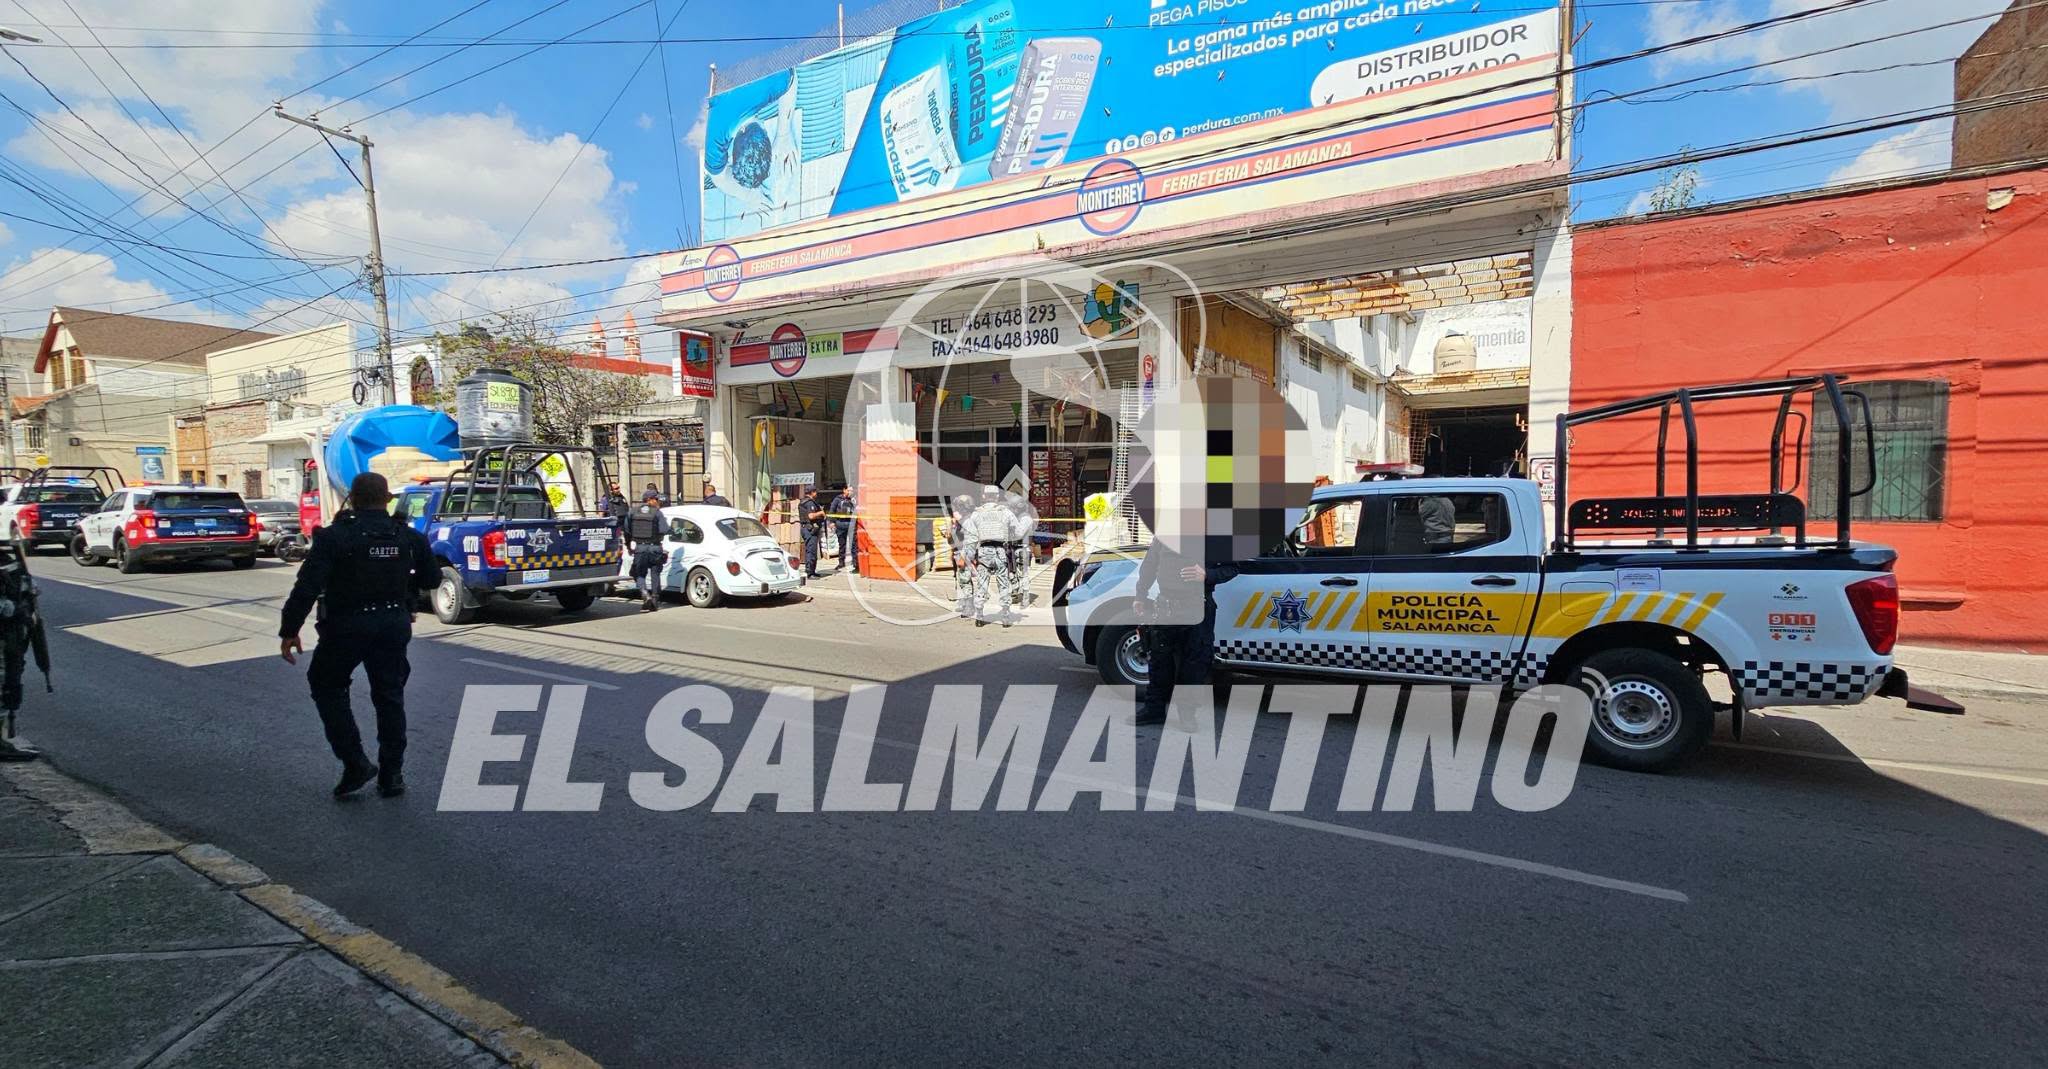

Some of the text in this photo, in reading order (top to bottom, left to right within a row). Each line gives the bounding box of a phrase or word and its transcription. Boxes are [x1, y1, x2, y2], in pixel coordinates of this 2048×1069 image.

[1149, 4, 1194, 28] PEGA
[1154, 33, 1287, 77] especializados
[1292, 20, 1339, 48] para
[1344, 3, 1398, 30] cada
[1167, 38, 1190, 55] La
[1194, 23, 1248, 50] gama
[1252, 11, 1293, 34] más
[1357, 23, 1528, 80] DISTRIBUIDOR
[964, 22, 986, 146] PERDURA
[928, 88, 944, 136] PERDURA
[1007, 54, 1059, 174] PERDURA
[1181, 106, 1284, 138] perdura.com.mx
[995, 105, 1019, 163] PERDURA
[883, 109, 911, 195] PERDURA
[1161, 141, 1352, 193] FERRETERIA SALAMANCA
[1078, 181, 1145, 214] MONTERREY
[751, 244, 852, 273] FERRETERIA SALAMANCA
[704, 263, 742, 284] MONTERREY
[931, 317, 958, 335] TEL.
[770, 341, 806, 360] MONTERREY
[810, 340, 838, 354] EXTRA
[506, 529, 526, 539] 1070
[579, 527, 613, 536] POLICÍA
[1377, 608, 1501, 622] MUNICIPAL
[1391, 593, 1484, 608] POLICÍA
[1382, 621, 1496, 634] SALAMANCA
[1770, 614, 1814, 626] 911
